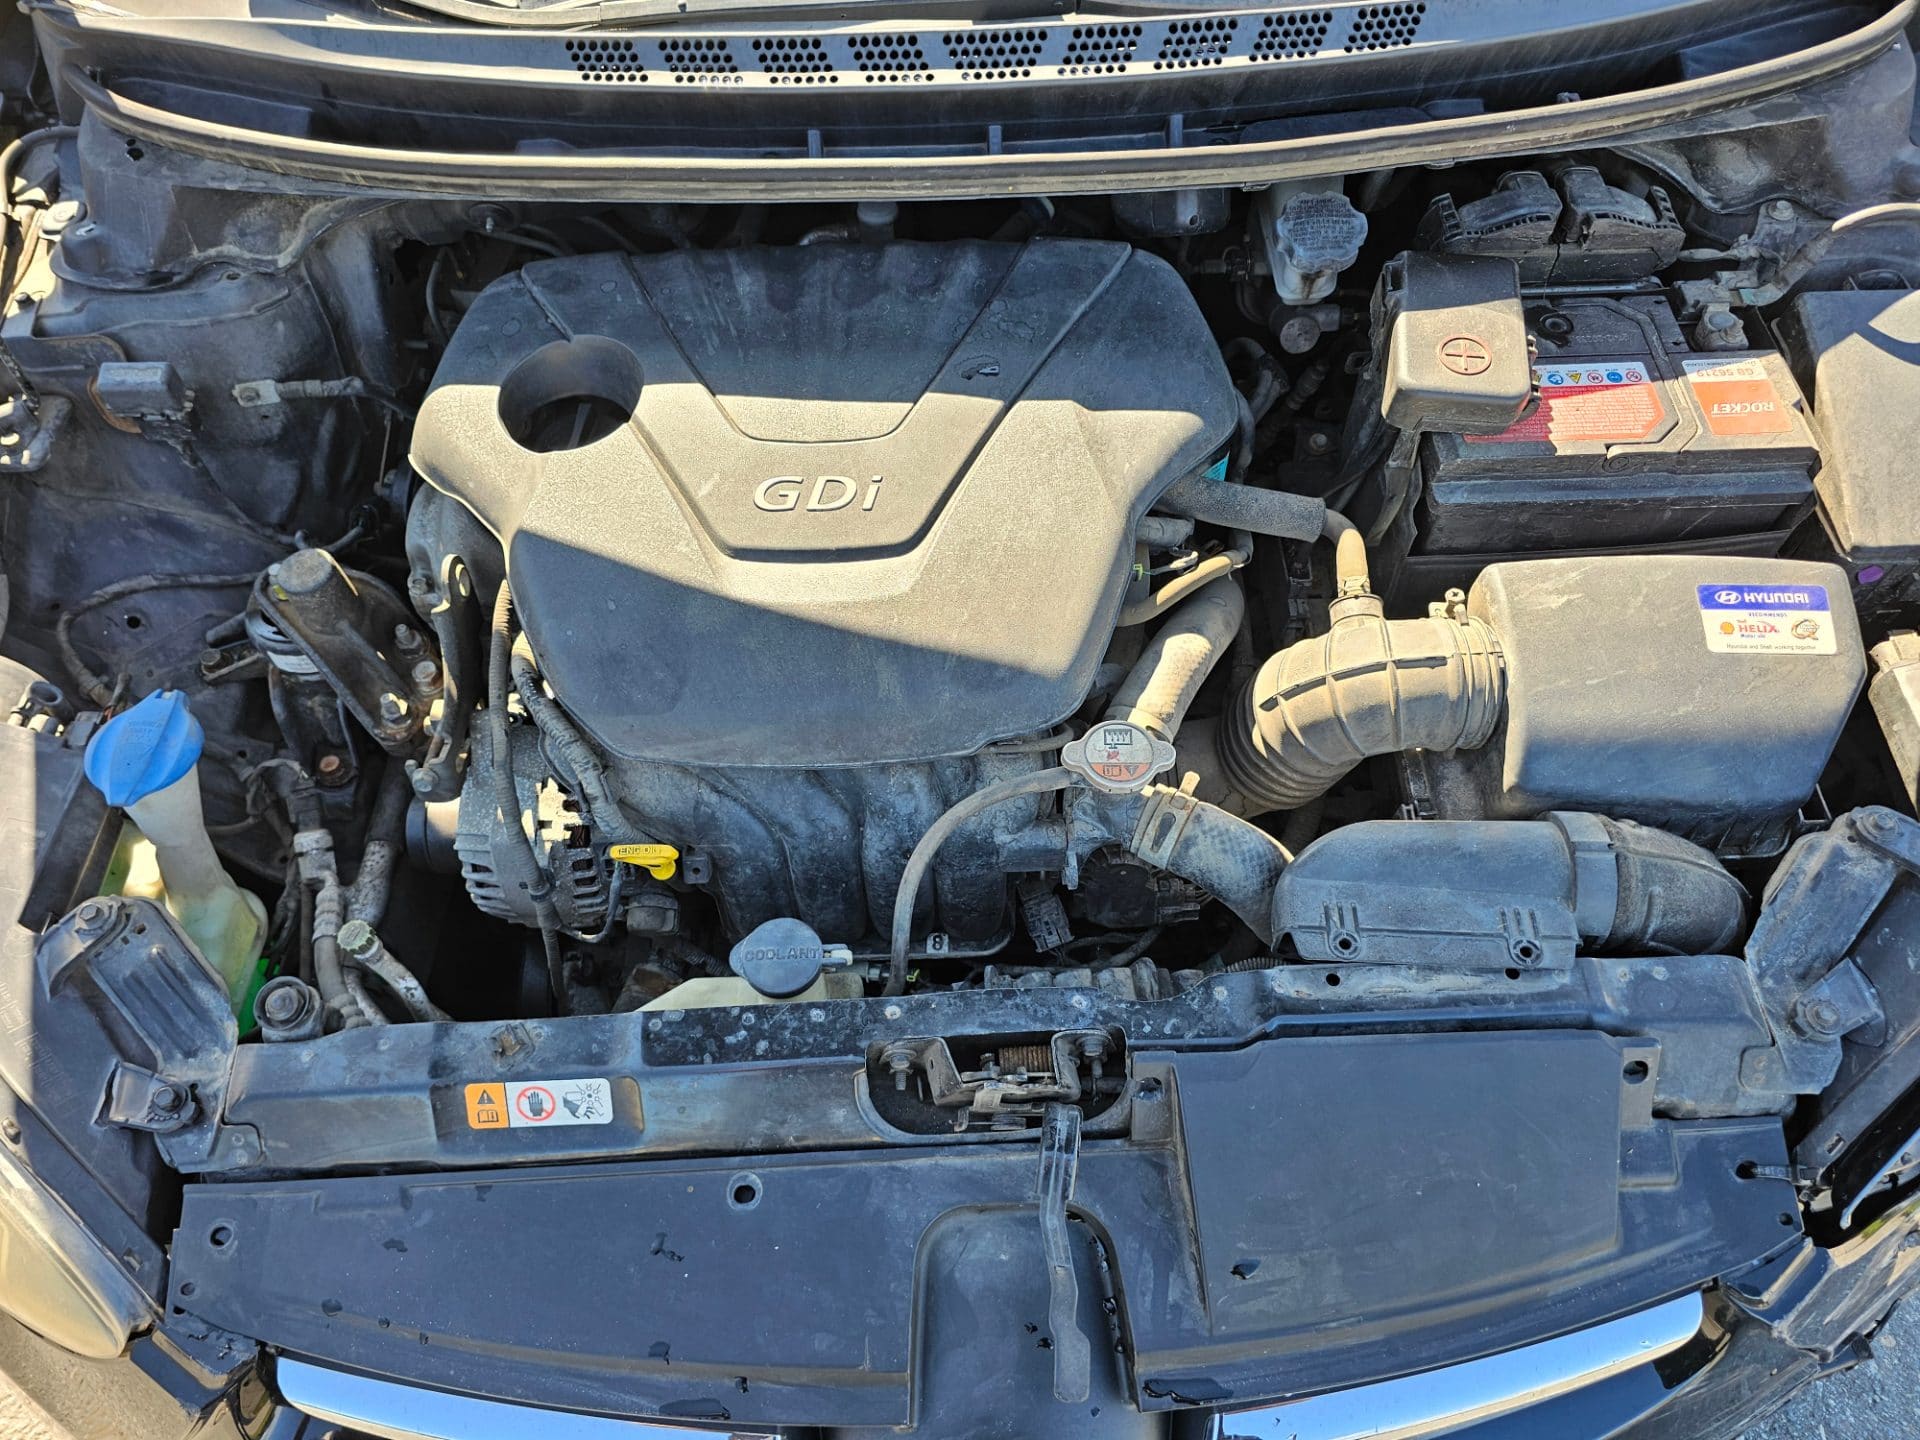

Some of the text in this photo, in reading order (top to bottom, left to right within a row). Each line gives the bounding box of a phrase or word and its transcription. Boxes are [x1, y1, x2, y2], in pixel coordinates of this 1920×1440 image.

[1711, 401, 1776, 414] ROCKET
[753, 474, 884, 513] GDi
[1743, 592, 1809, 604] HYUNDAI
[1738, 624, 1778, 633] HELIX
[932, 934, 944, 951] 8
[744, 947, 821, 961] COOLANT
